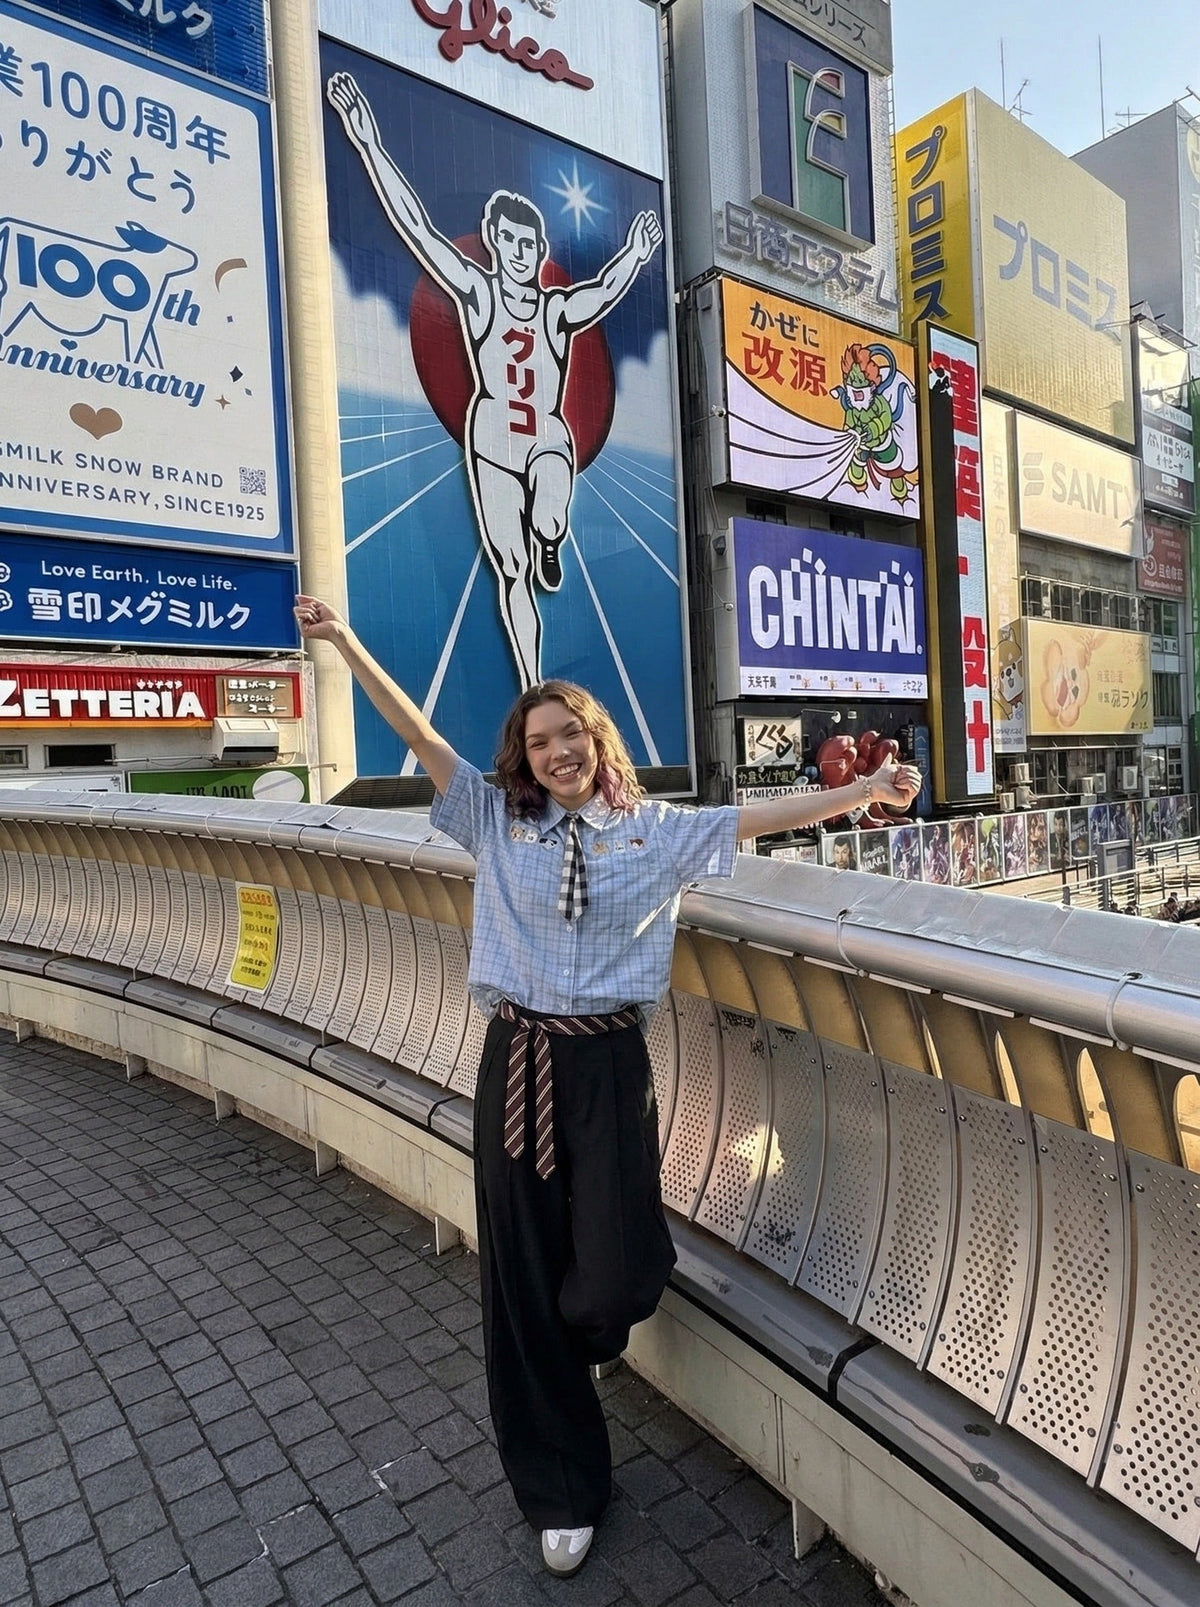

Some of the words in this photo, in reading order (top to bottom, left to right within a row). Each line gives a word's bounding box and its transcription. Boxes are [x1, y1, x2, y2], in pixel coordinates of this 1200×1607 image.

[117, 0, 213, 38] ルク
[0, 119, 195, 214] りがとう
[905, 124, 951, 323] プロミス
[993, 213, 1122, 342] プロミス
[750, 301, 820, 348] かぜに
[0, 336, 206, 407] nniversary
[502, 326, 537, 437] グリコ
[741, 332, 828, 397] 改源
[0, 441, 63, 466] MILK
[75, 452, 142, 476] SNOW
[152, 465, 224, 489] BRAND
[41, 559, 86, 579] Love
[92, 564, 150, 585] Earth.
[158, 570, 197, 588] Love
[202, 573, 238, 591] Life.
[28, 587, 251, 631] 雪印メグミルク
[0, 680, 206, 718] ZETTERIA
